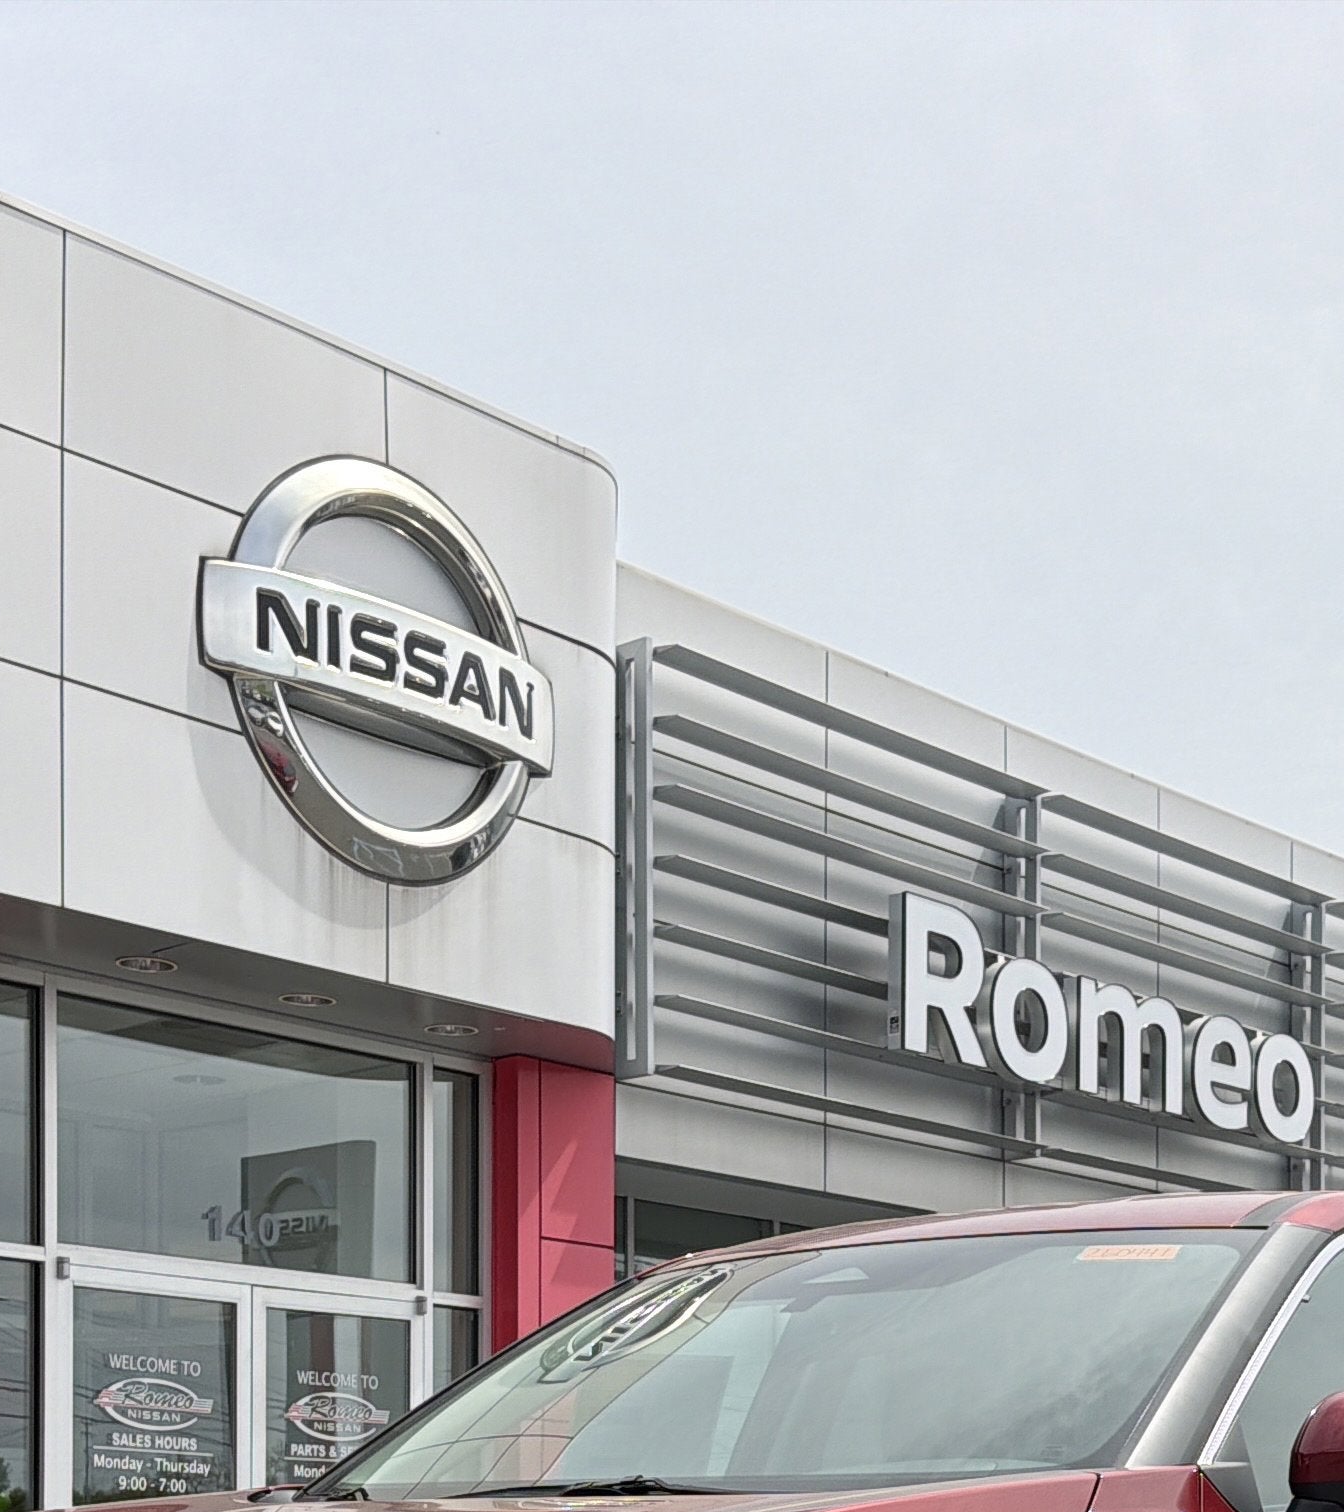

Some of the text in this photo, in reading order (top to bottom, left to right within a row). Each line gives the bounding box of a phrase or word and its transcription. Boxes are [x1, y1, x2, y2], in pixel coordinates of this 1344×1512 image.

[256, 587, 536, 742] NISSAN
[896, 891, 1314, 1143] Romeo
[201, 1205, 281, 1247] 140
[109, 1353, 201, 1376] WELCOME TO
[296, 1370, 379, 1390] WELCOME TO
[120, 1381, 194, 1409] Romeo
[127, 1409, 181, 1423] NISSAN
[305, 1395, 373, 1420] Romeo
[314, 1421, 361, 1433] NISSAN
[112, 1432, 198, 1451] SALES HOURS
[290, 1443, 326, 1458] PARTS
[329, 1445, 338, 1458] &
[93, 1454, 144, 1473] Monday
[154, 1457, 211, 1477] Thursday
[294, 1464, 326, 1478] Mond
[118, 1475, 147, 1491] 9:00
[159, 1478, 187, 1493] 7:00
